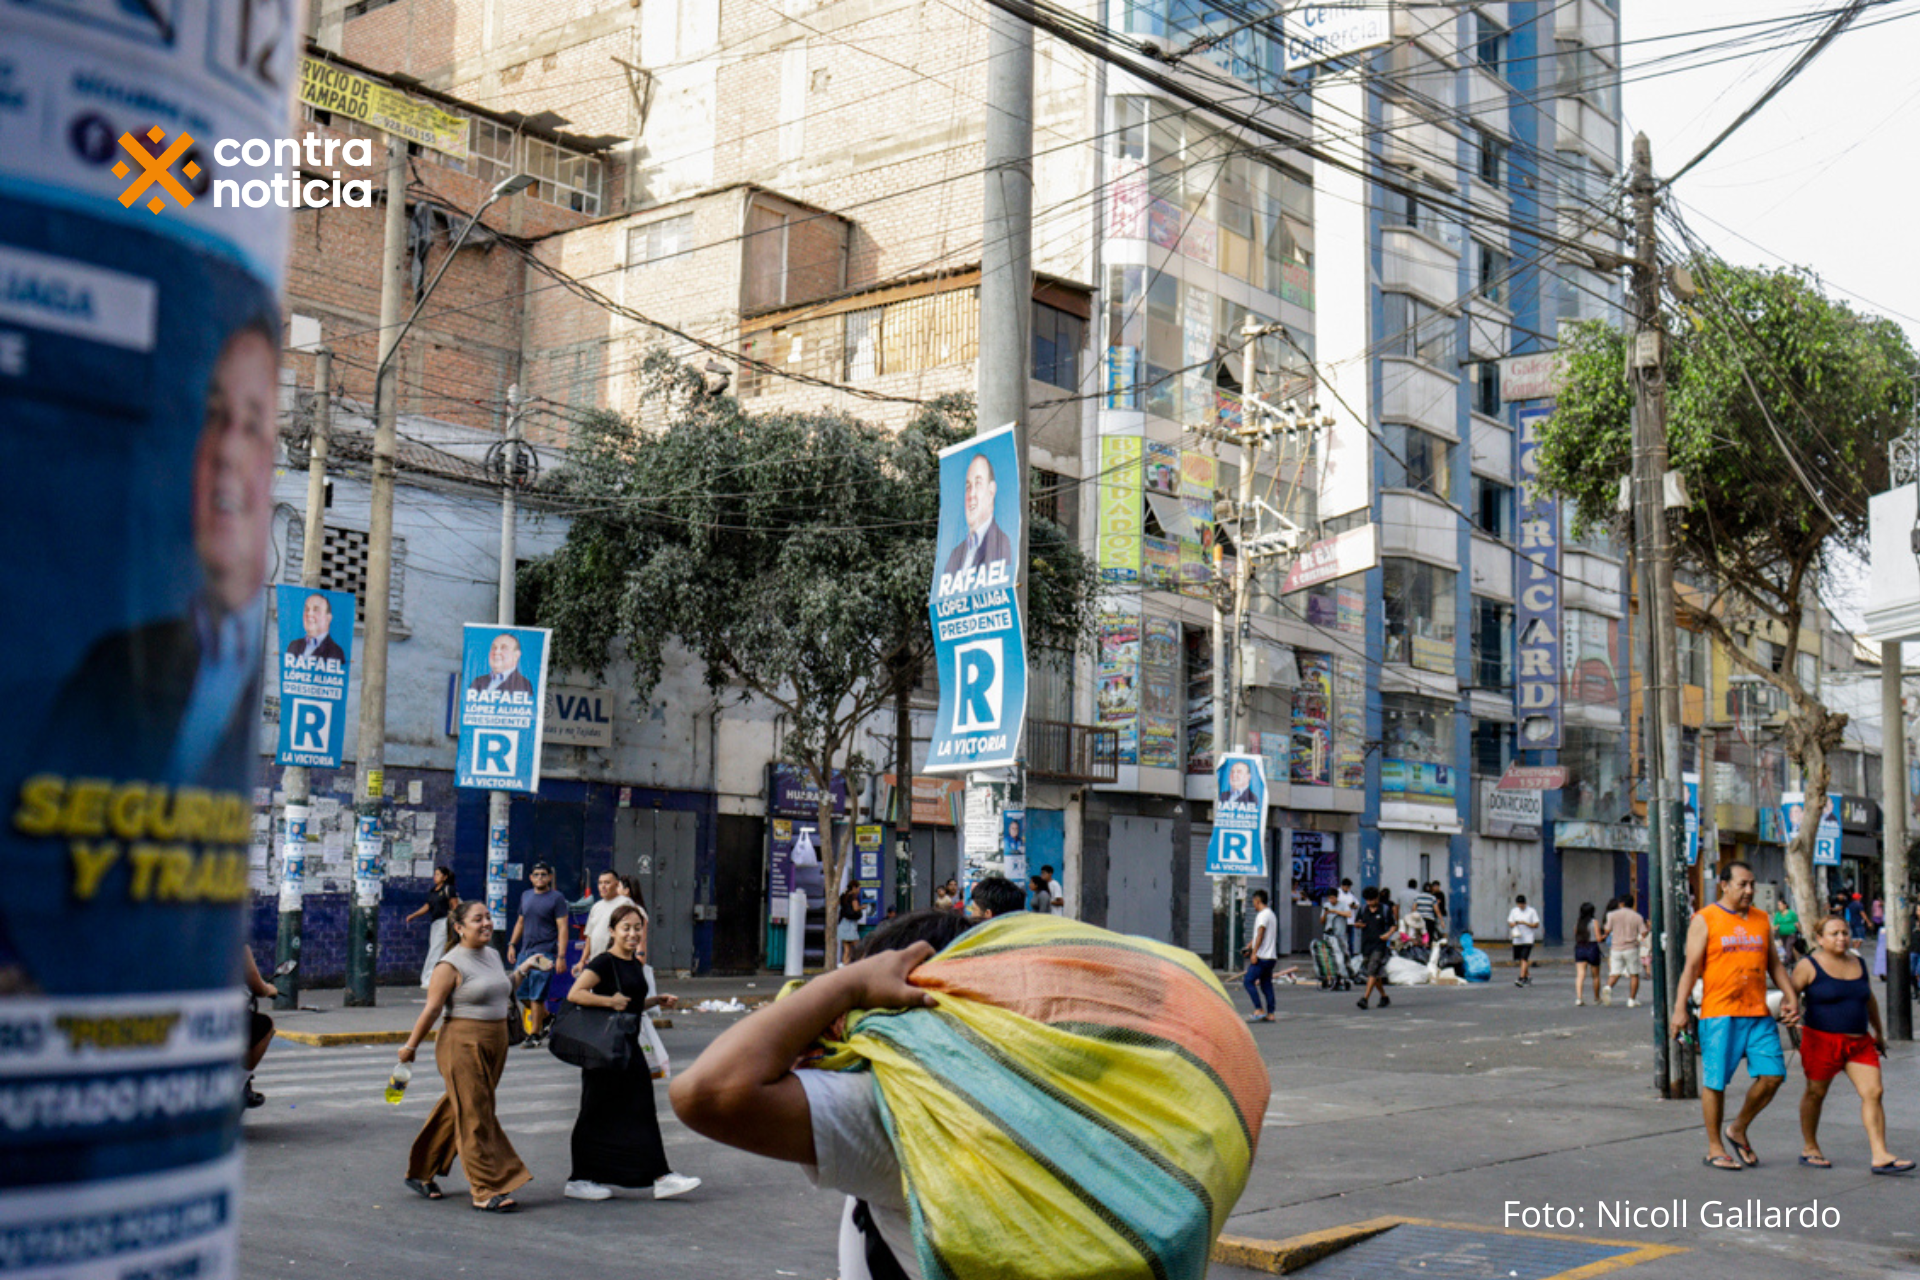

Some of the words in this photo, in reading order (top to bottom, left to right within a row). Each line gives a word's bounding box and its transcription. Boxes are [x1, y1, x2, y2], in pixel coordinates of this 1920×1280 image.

[1289, 19, 1384, 61] Comercial
[302, 61, 349, 94] RVICIO
[351, 79, 371, 100] DE
[301, 80, 368, 118] TAMPADO
[1106, 437, 1136, 567] BORDADOS
[938, 558, 1010, 597] RAFAEL
[936, 597, 971, 618] LÓPEZ
[972, 589, 1011, 611] ALIAGA
[940, 611, 1010, 639] PRESIDENTE
[283, 668, 312, 683] LÓPEZ
[313, 674, 344, 687] ALIAGA
[284, 653, 346, 675] RAFAEL
[284, 682, 340, 698] PRESIDENTE
[466, 688, 534, 706] RAFAEL
[957, 648, 996, 726] R
[464, 714, 529, 728] PRESIDENTE
[465, 704, 496, 715] LÓPEZ
[496, 706, 532, 716] ALIAGA
[556, 694, 610, 725] VAL
[294, 703, 327, 749] R
[282, 751, 293, 763] LA
[294, 753, 334, 767] VICTORIA
[476, 733, 512, 772] R
[937, 739, 953, 757] LA
[954, 735, 1007, 756] VICTORIA
[460, 776, 474, 786] LA
[475, 777, 523, 789] VICTORIA
[1508, 795, 1540, 813] RICARDO
[1222, 832, 1248, 860] R
[1818, 839, 1832, 857] R
[69, 841, 119, 899] Y
[1211, 862, 1220, 870] LA
[1222, 864, 1258, 873] VICTORIA
[0, 1074, 138, 1131] UTADO
